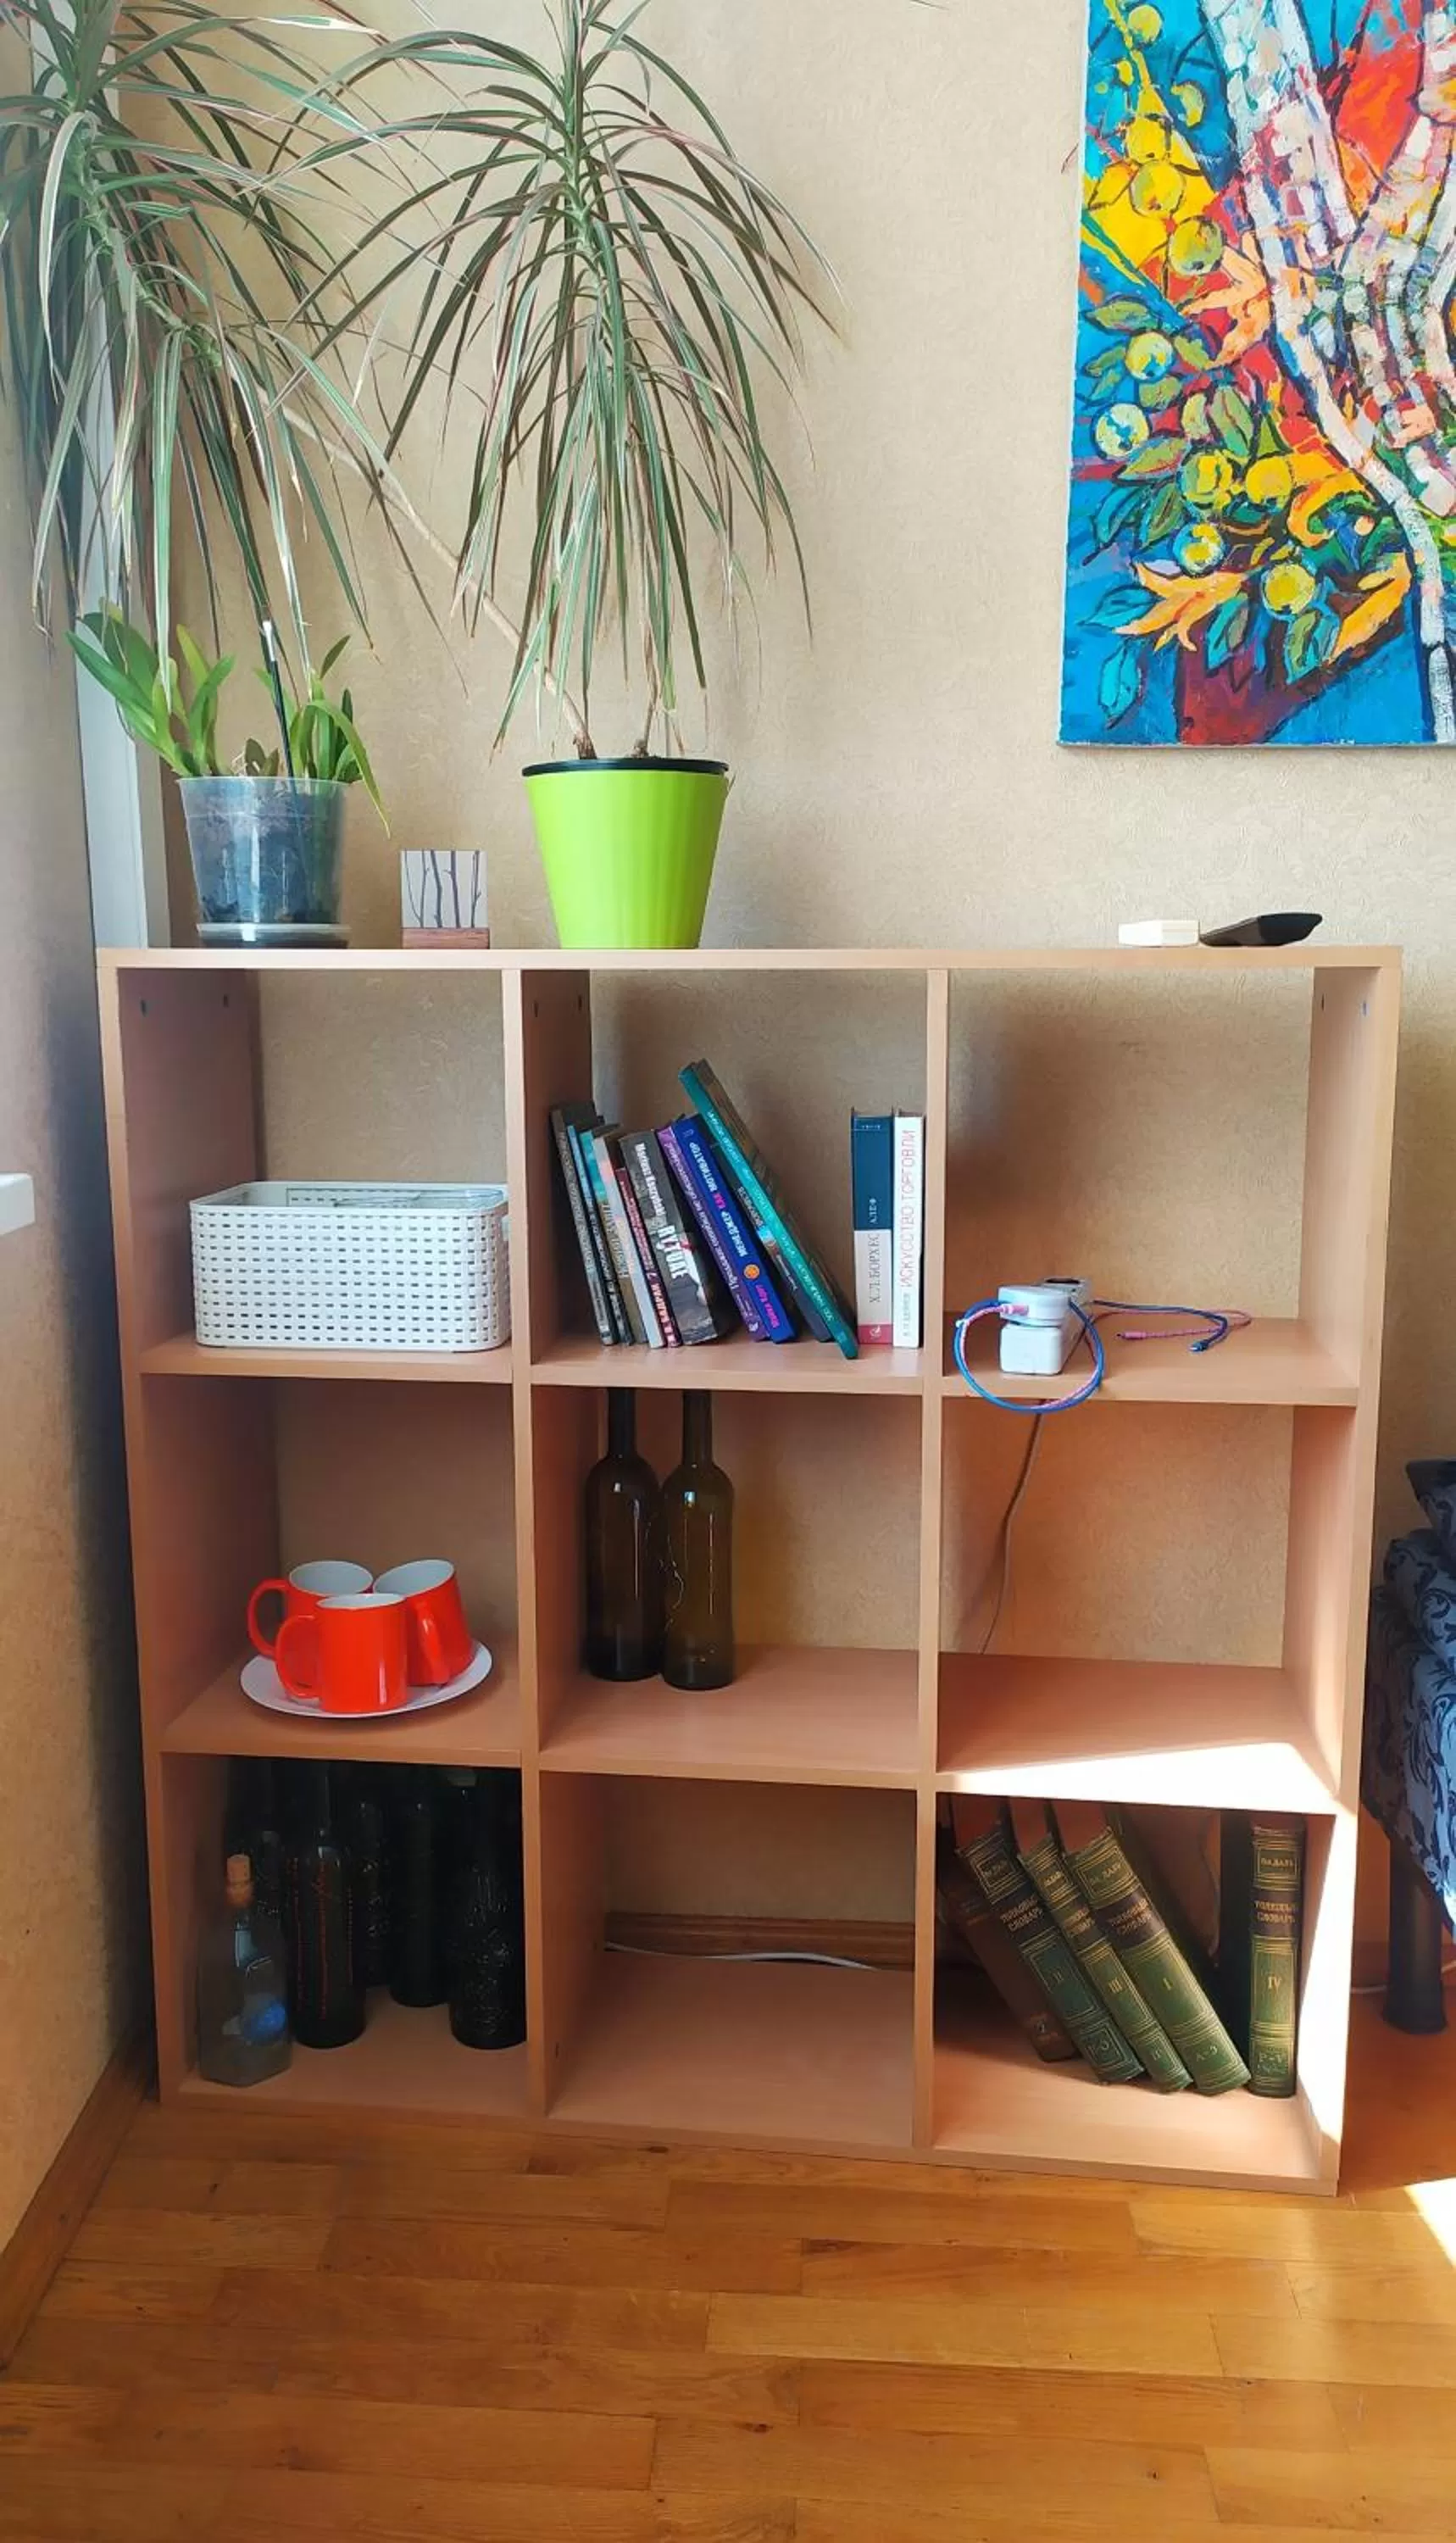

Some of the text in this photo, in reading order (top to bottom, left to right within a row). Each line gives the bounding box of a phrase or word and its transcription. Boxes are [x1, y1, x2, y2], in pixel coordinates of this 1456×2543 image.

[689, 1141, 718, 1192] МОТИВАТОР
[869, 1197, 877, 1224] АЛЕФ
[898, 1129, 915, 1288] ИСКУССТВО ТОРГОВЛИ
[720, 1210, 747, 1256] МЕНЕДЖЕР
[1109, 1977, 1123, 1994] III
[1268, 1976, 1282, 1991] IV
